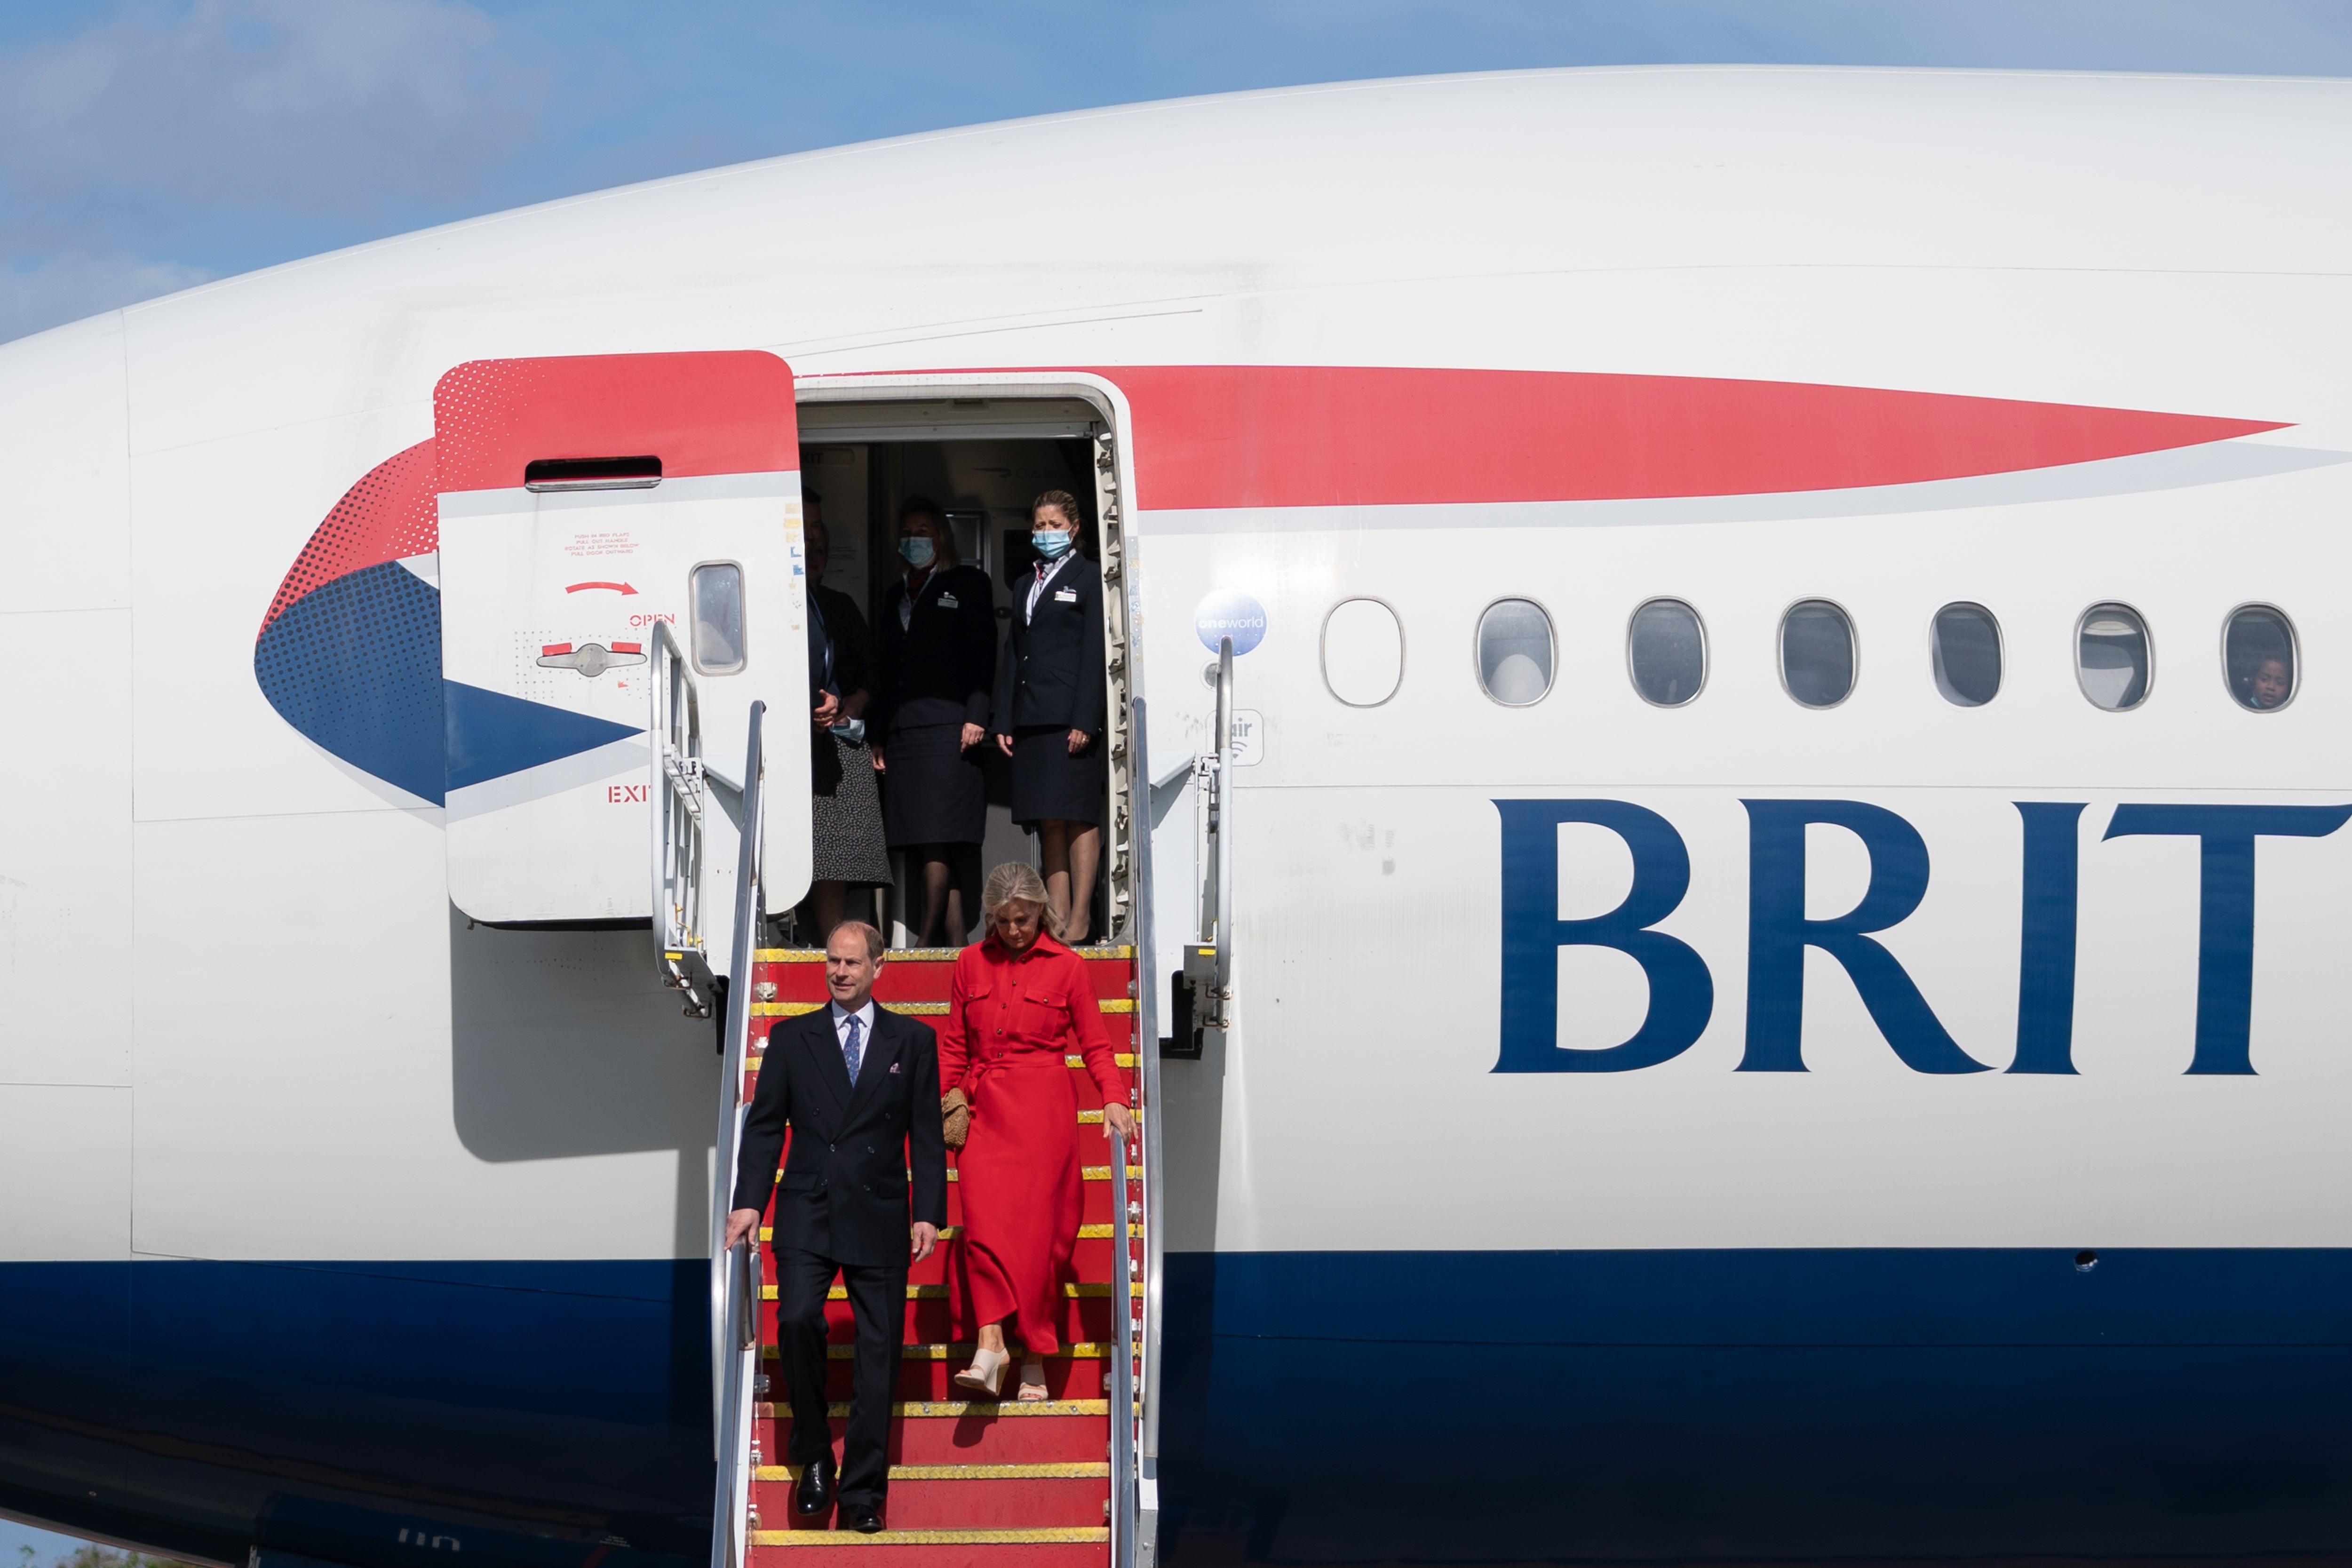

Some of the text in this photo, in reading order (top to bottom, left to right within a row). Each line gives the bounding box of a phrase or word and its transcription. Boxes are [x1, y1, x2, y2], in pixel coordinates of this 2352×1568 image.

[801, 452, 824, 464] XIT
[629, 613, 675, 627] OPEN
[1199, 616, 1263, 629] oneworld
[608, 784, 651, 803] EXI
[1489, 798, 2352, 1075] BRIT
